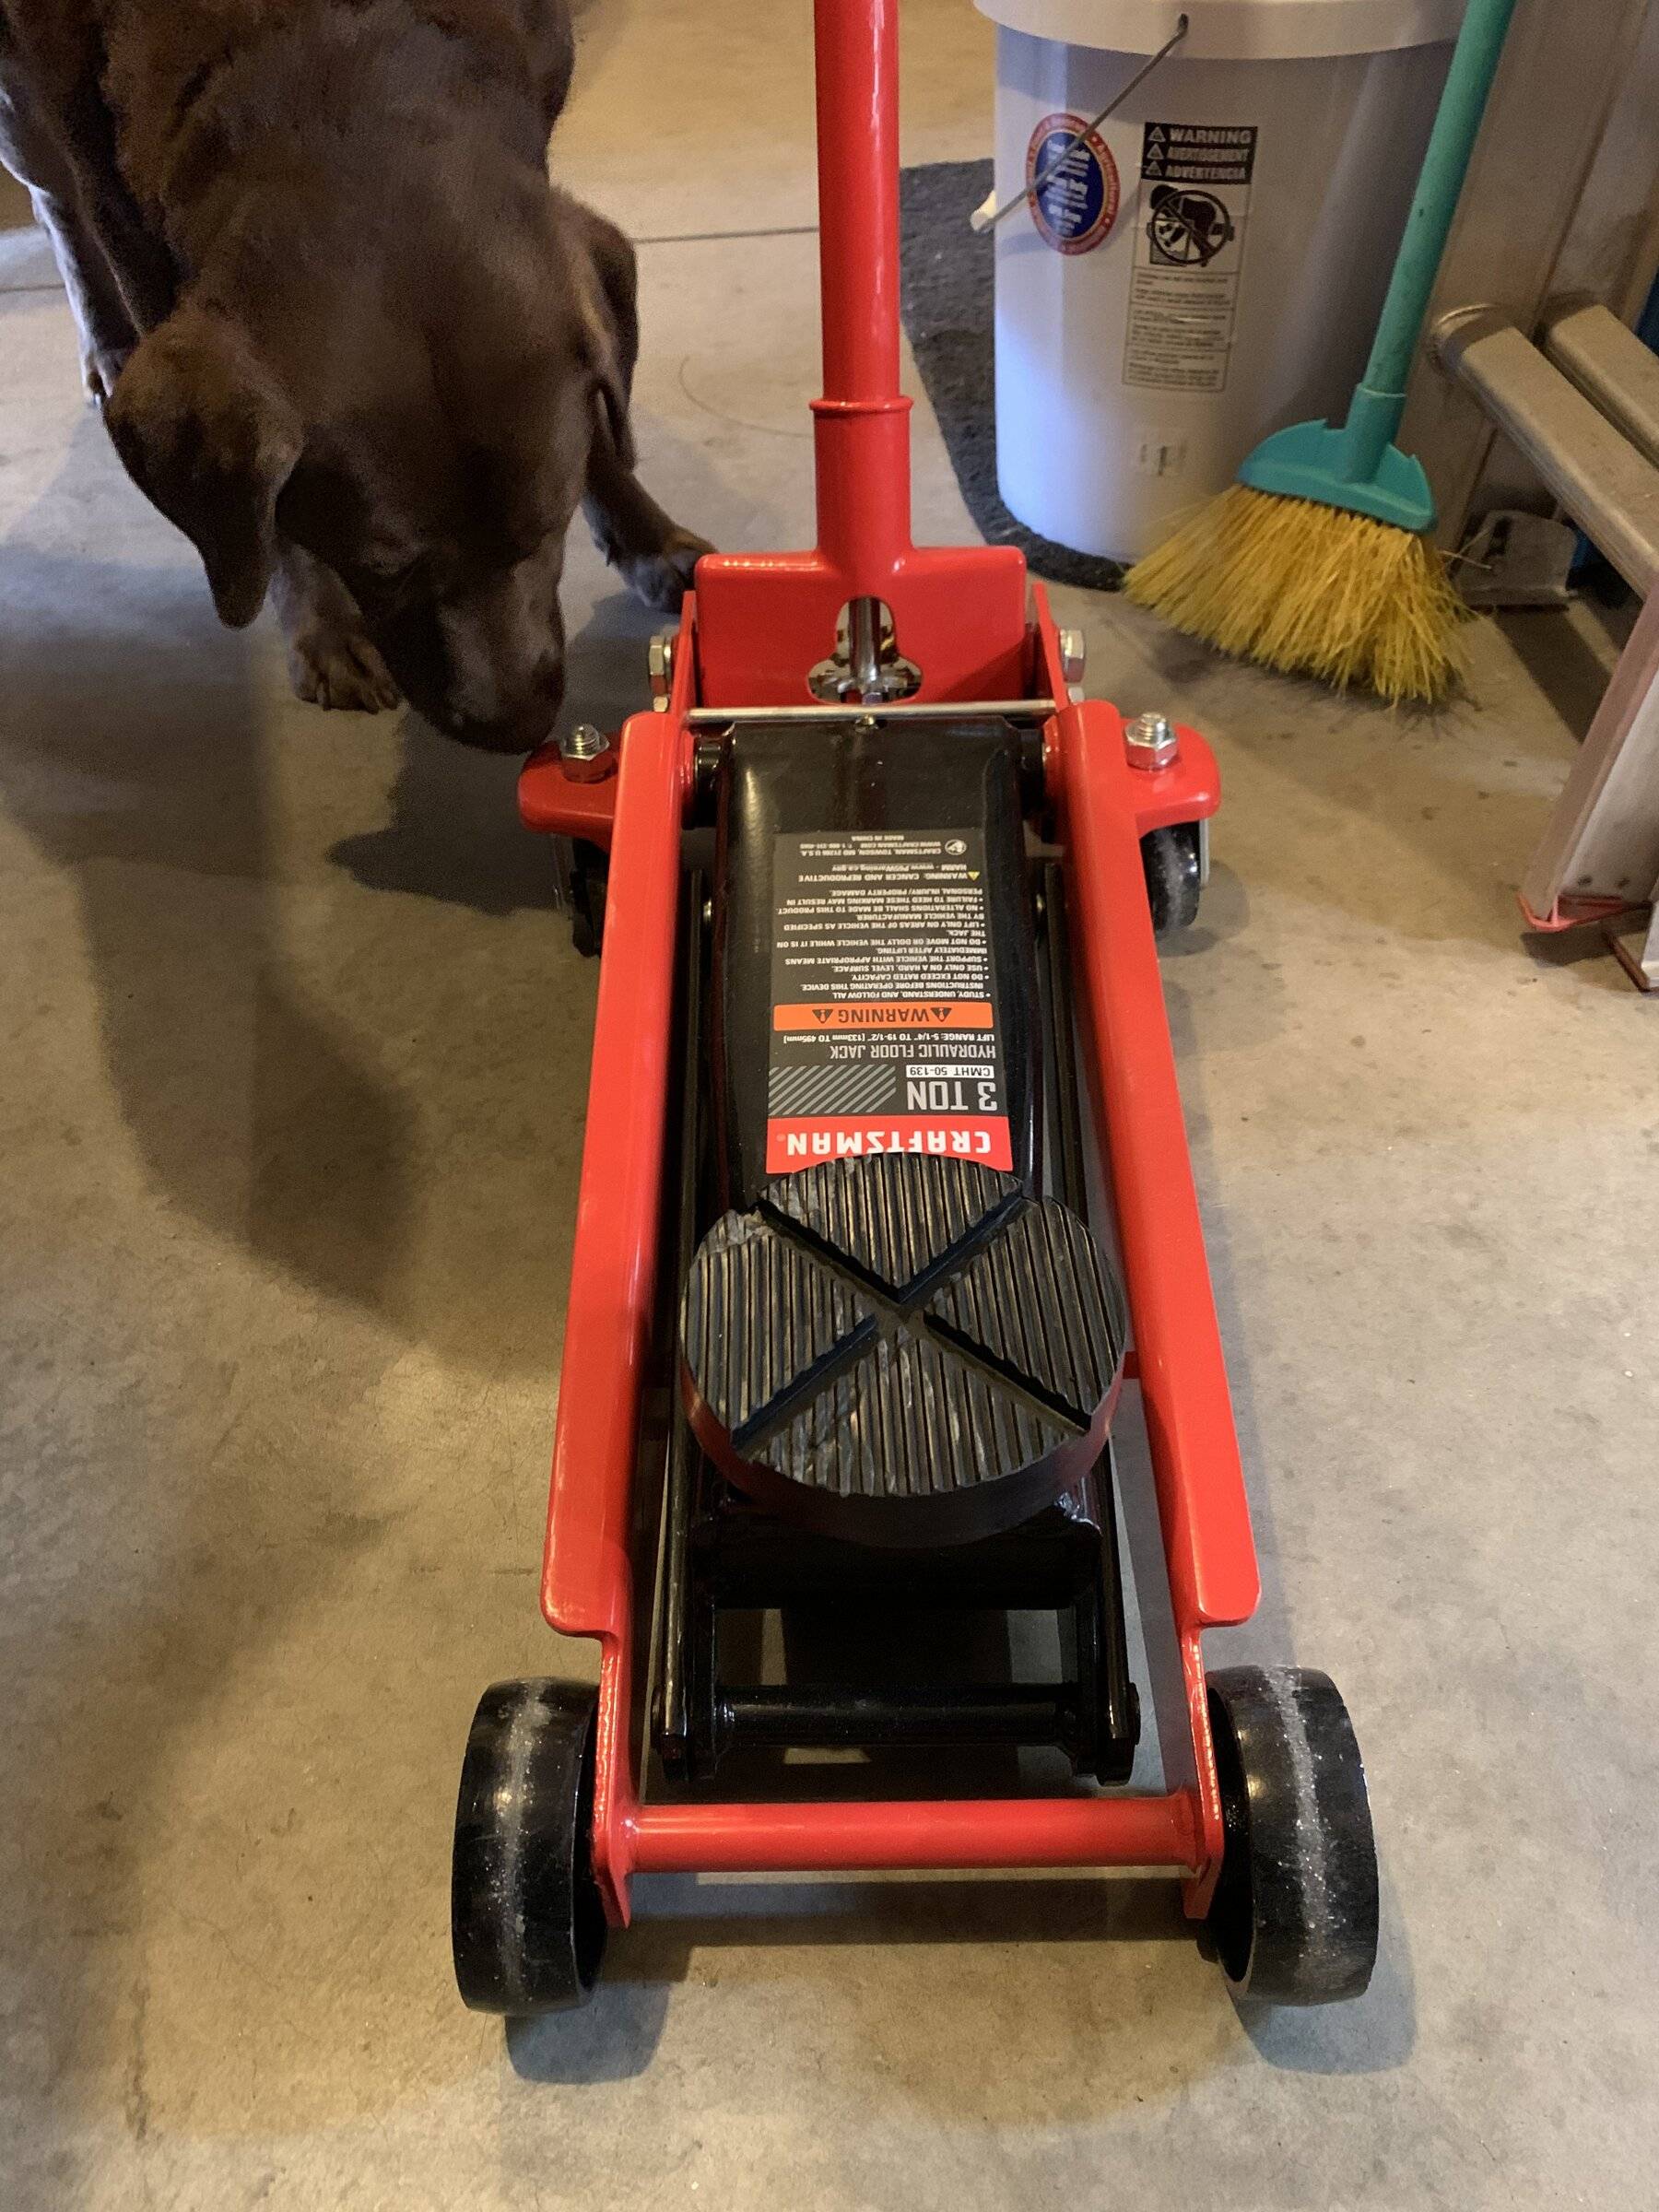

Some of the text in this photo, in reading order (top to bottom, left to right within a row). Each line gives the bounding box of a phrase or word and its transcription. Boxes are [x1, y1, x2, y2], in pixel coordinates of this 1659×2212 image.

[1170, 128, 1252, 144] WARNING
[839, 1008, 929, 1023] WARNING
[830, 1044, 995, 1058] HYDRAULIC FLOOR JACK
[910, 1066, 991, 1077] CMHT 50-139
[907, 1081, 997, 1112] 3 TON
[787, 1131, 991, 1156] CRAFTSMAN
